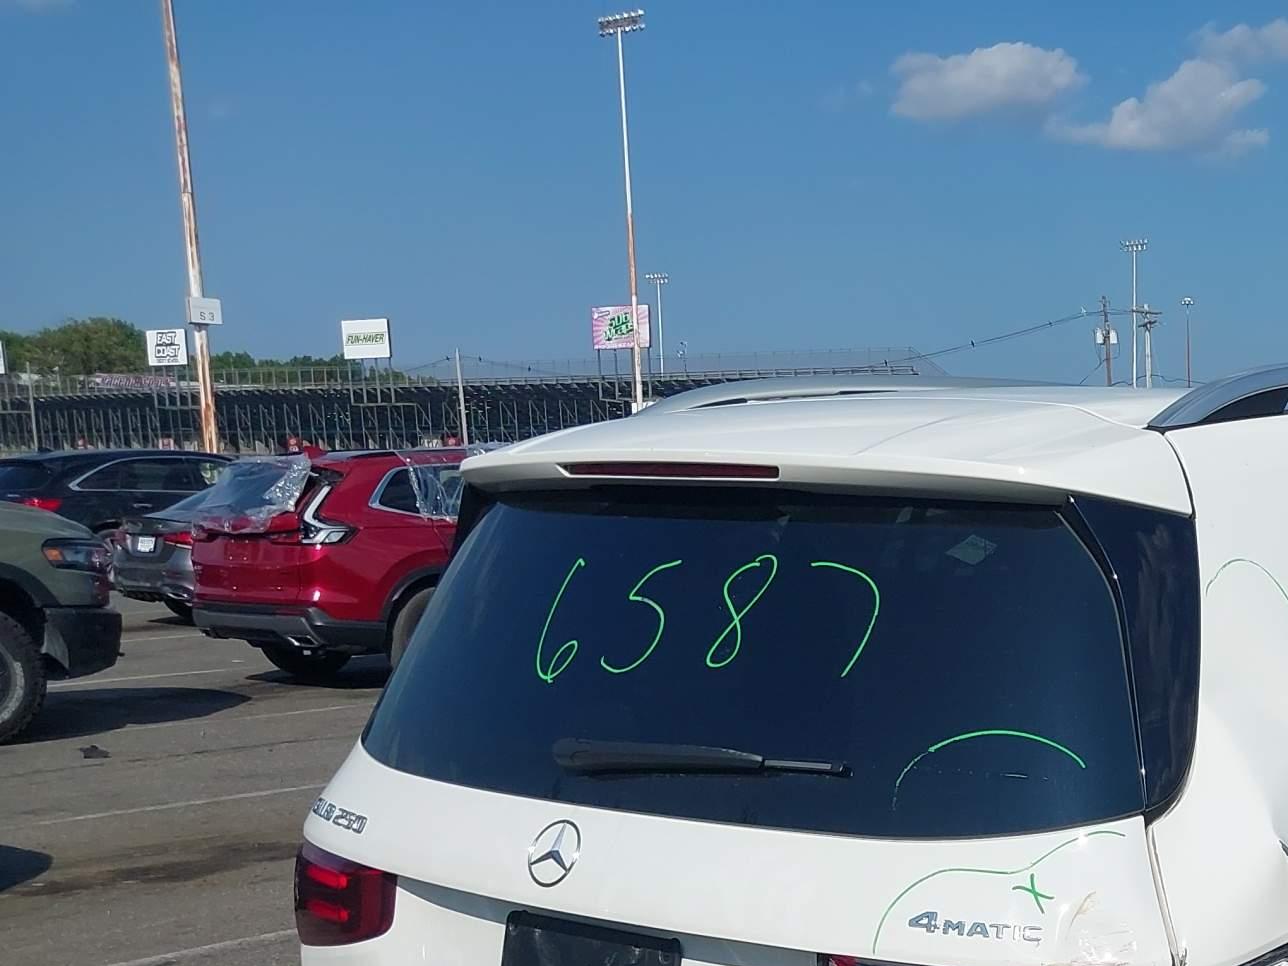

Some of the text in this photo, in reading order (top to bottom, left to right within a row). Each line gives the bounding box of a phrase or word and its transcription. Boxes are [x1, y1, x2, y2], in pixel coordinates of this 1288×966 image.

[157, 332, 177, 345] EAST
[345, 333, 385, 345] FUN-HAVER
[155, 344, 180, 358] COAST
[537, 554, 880, 683] 6587
[332, 807, 368, 834] 250
